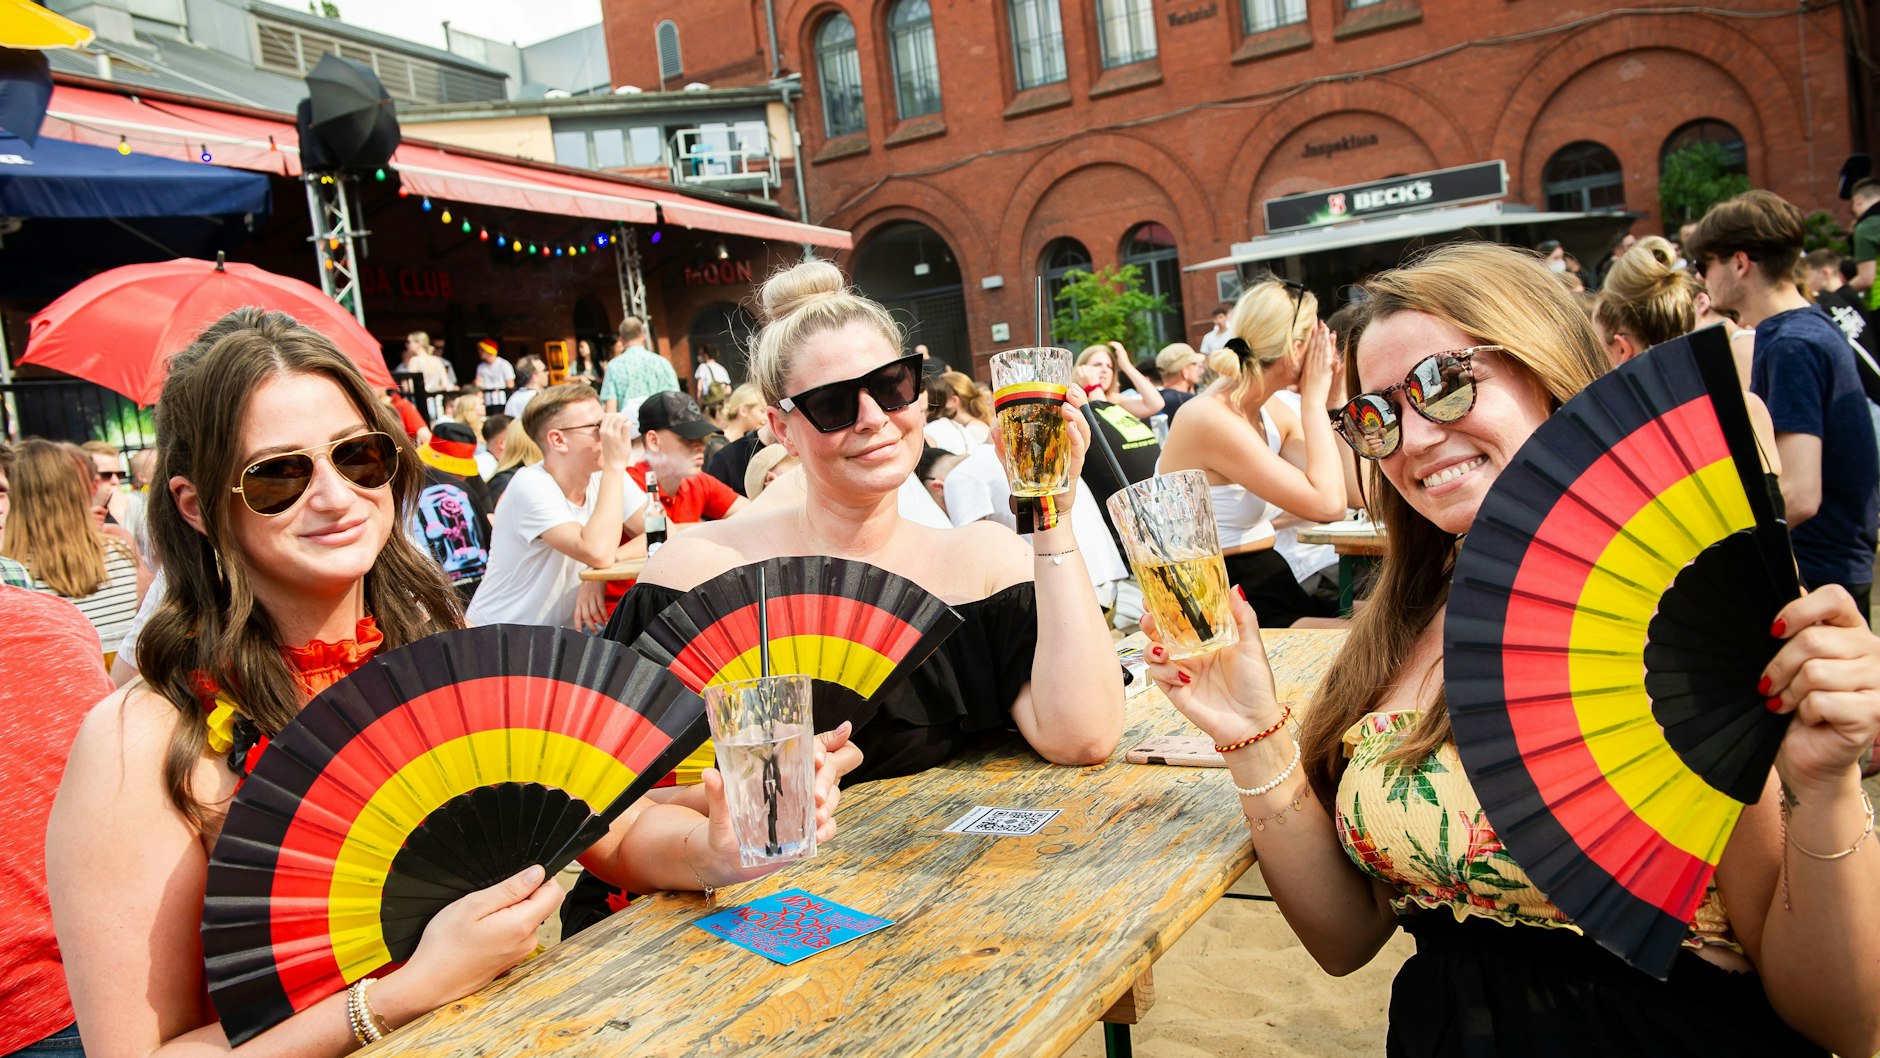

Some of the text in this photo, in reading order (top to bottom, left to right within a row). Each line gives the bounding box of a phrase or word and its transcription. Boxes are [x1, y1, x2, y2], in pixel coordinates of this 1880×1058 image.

[1353, 180, 1433, 210] BECK'S
[399, 268, 453, 299] CLUB
[685, 260, 753, 287] MOON
[776, 895, 832, 916] HKW
[732, 905, 831, 949] EDUCATION
[773, 906, 841, 935] SHOCK
